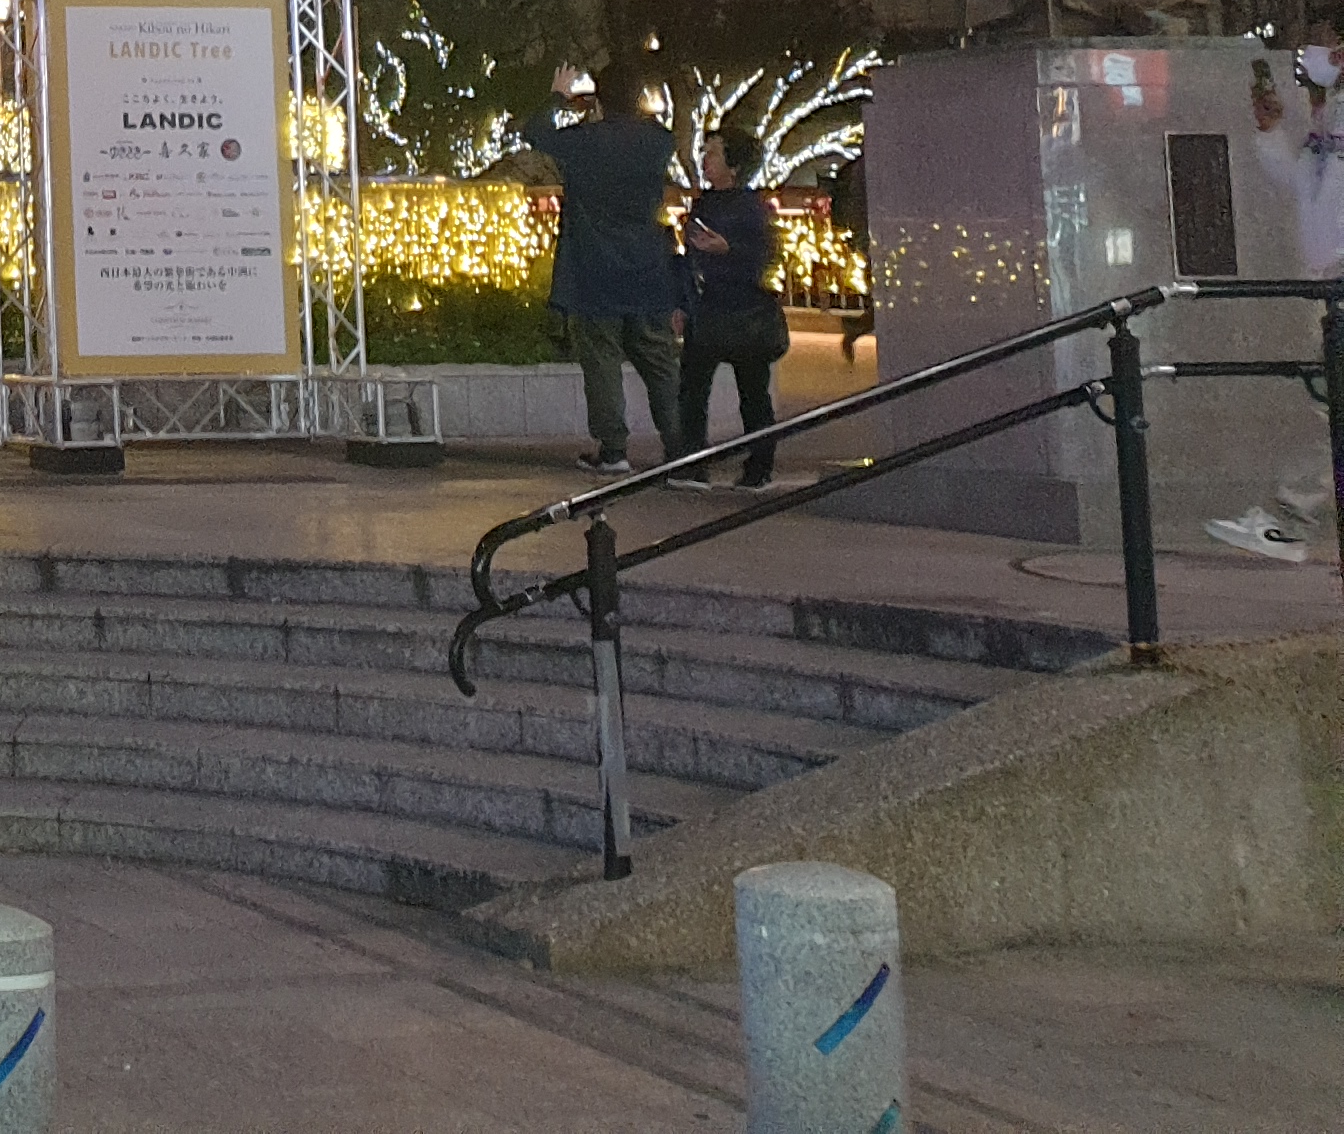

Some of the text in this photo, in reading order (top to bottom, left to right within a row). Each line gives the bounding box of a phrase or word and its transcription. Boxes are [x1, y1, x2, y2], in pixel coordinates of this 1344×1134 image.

[109, 40, 232, 59] LANDIC Tree
[122, 111, 223, 130] LANDIC
